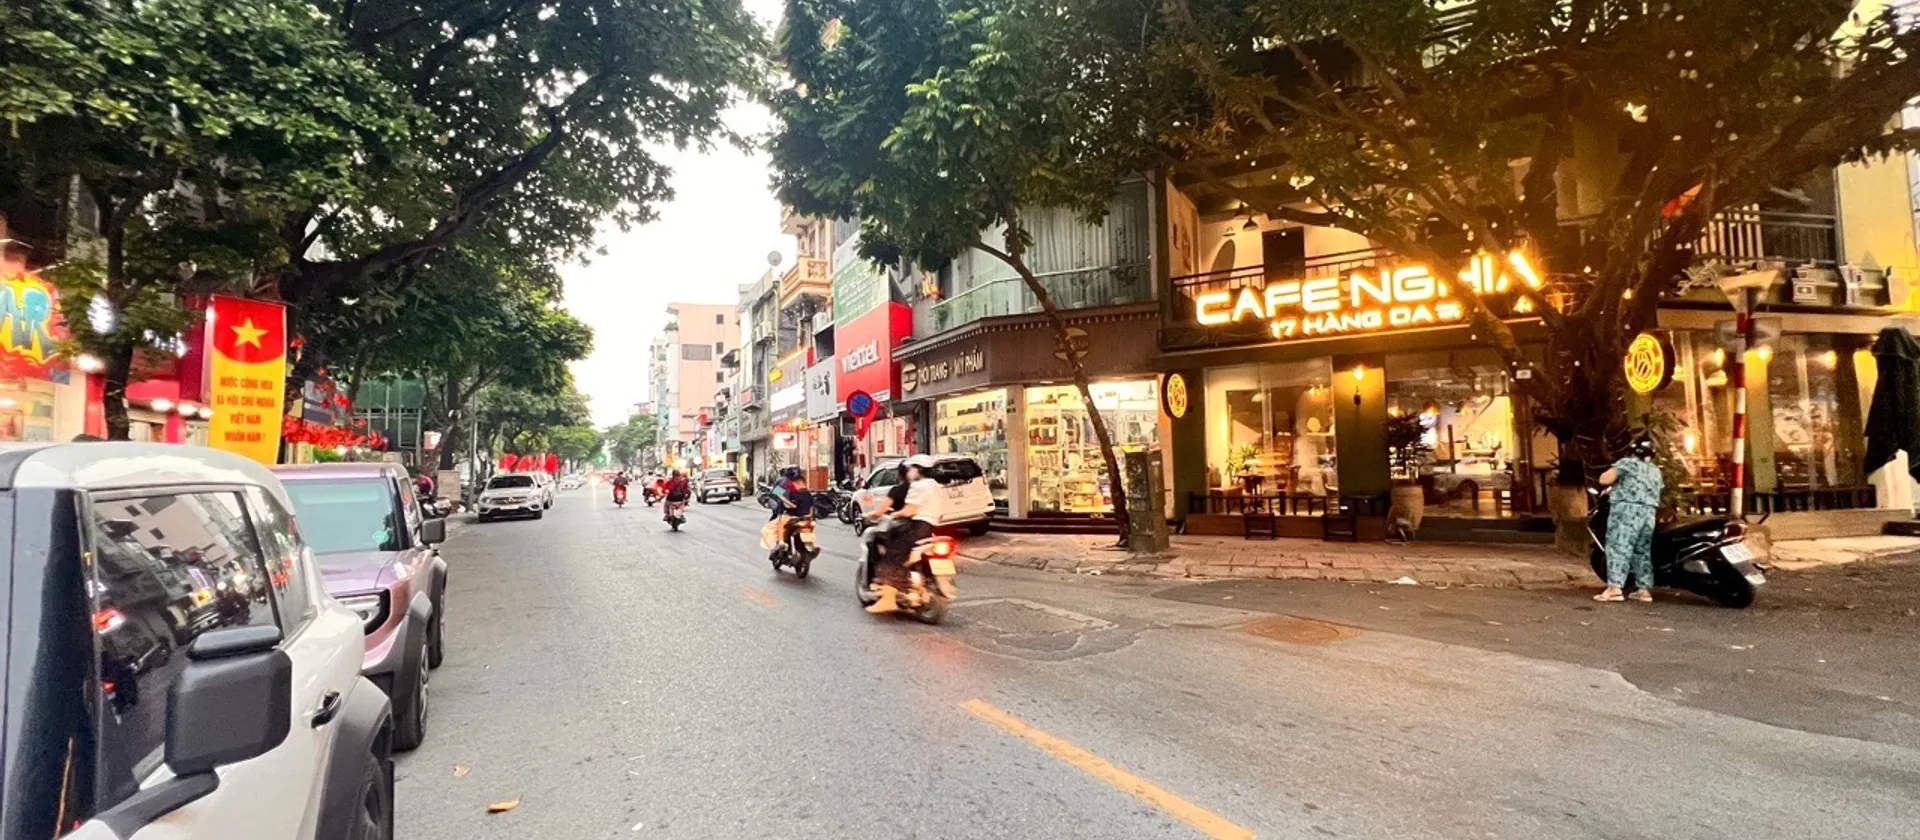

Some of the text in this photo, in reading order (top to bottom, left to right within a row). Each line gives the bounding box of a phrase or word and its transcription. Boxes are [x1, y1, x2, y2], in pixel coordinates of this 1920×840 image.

[1195, 274, 1341, 326] CAFE
[1271, 319, 1297, 338] 17
[1302, 310, 1382, 335] HÀNG
[1390, 305, 1433, 326] DA
[841, 339, 881, 373] viettel
[231, 411, 261, 426] VIỆT NAM
